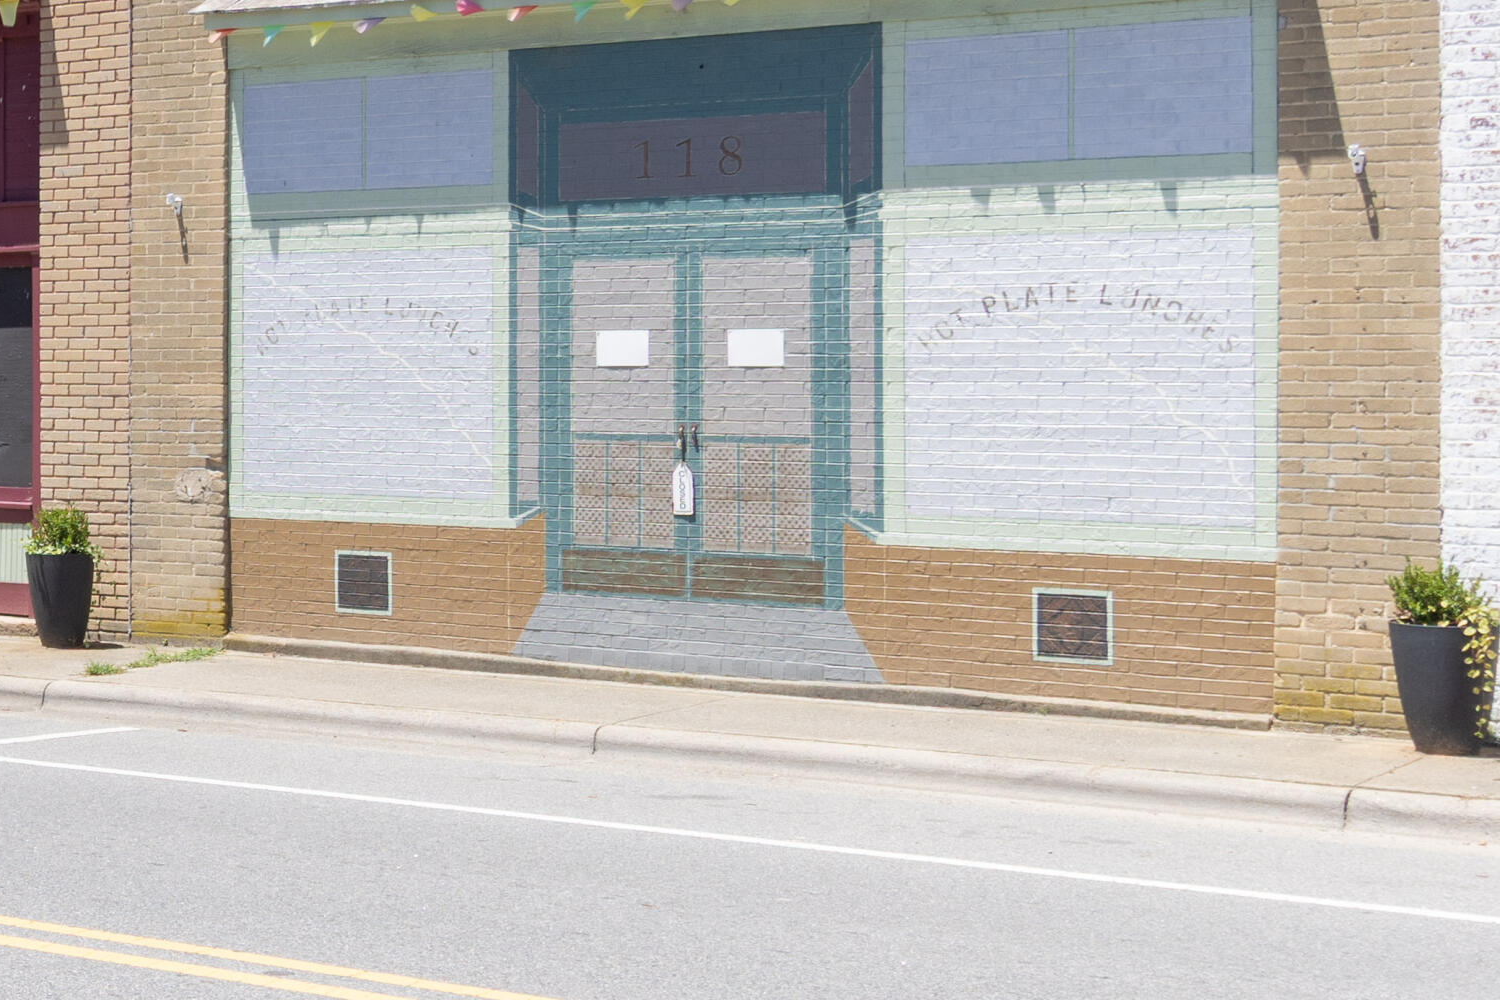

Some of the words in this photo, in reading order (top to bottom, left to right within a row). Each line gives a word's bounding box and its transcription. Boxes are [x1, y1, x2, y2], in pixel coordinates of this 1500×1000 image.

[633, 135, 743, 179] 118
[304, 295, 370, 324] LATE
[385, 297, 483, 357] LUNCHS
[916, 307, 966, 351] HOT
[981, 281, 1079, 318] PLATE
[1099, 283, 1241, 354] LUNCHES
